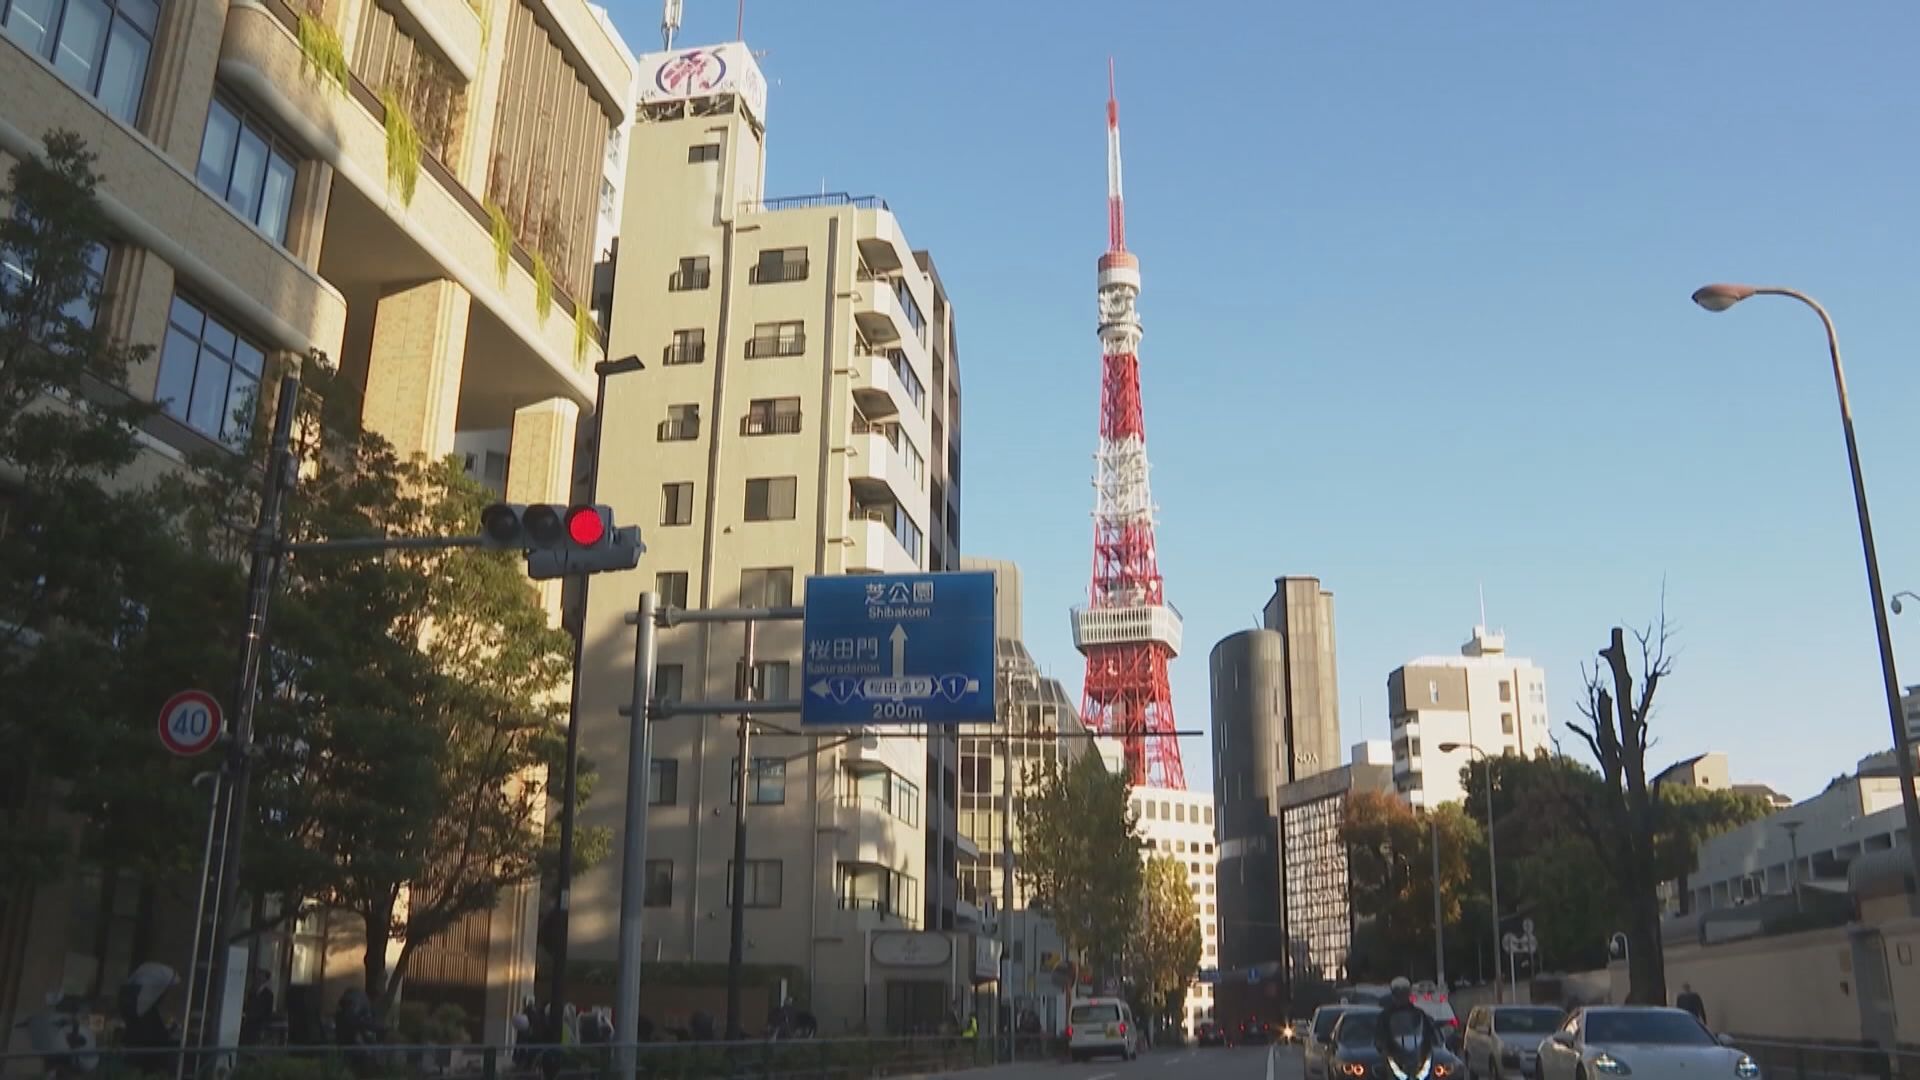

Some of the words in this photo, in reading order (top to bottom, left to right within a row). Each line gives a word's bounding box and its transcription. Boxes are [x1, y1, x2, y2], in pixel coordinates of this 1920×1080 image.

[865, 581, 934, 605] 芝公園
[868, 606, 931, 619] Shibakoen
[809, 637, 879, 660] 桜田門
[838, 679, 845, 696] 1
[869, 680, 926, 694] 桜田通り
[949, 678, 956, 694] 1
[873, 703, 923, 719] 200m
[172, 708, 207, 736] 40
